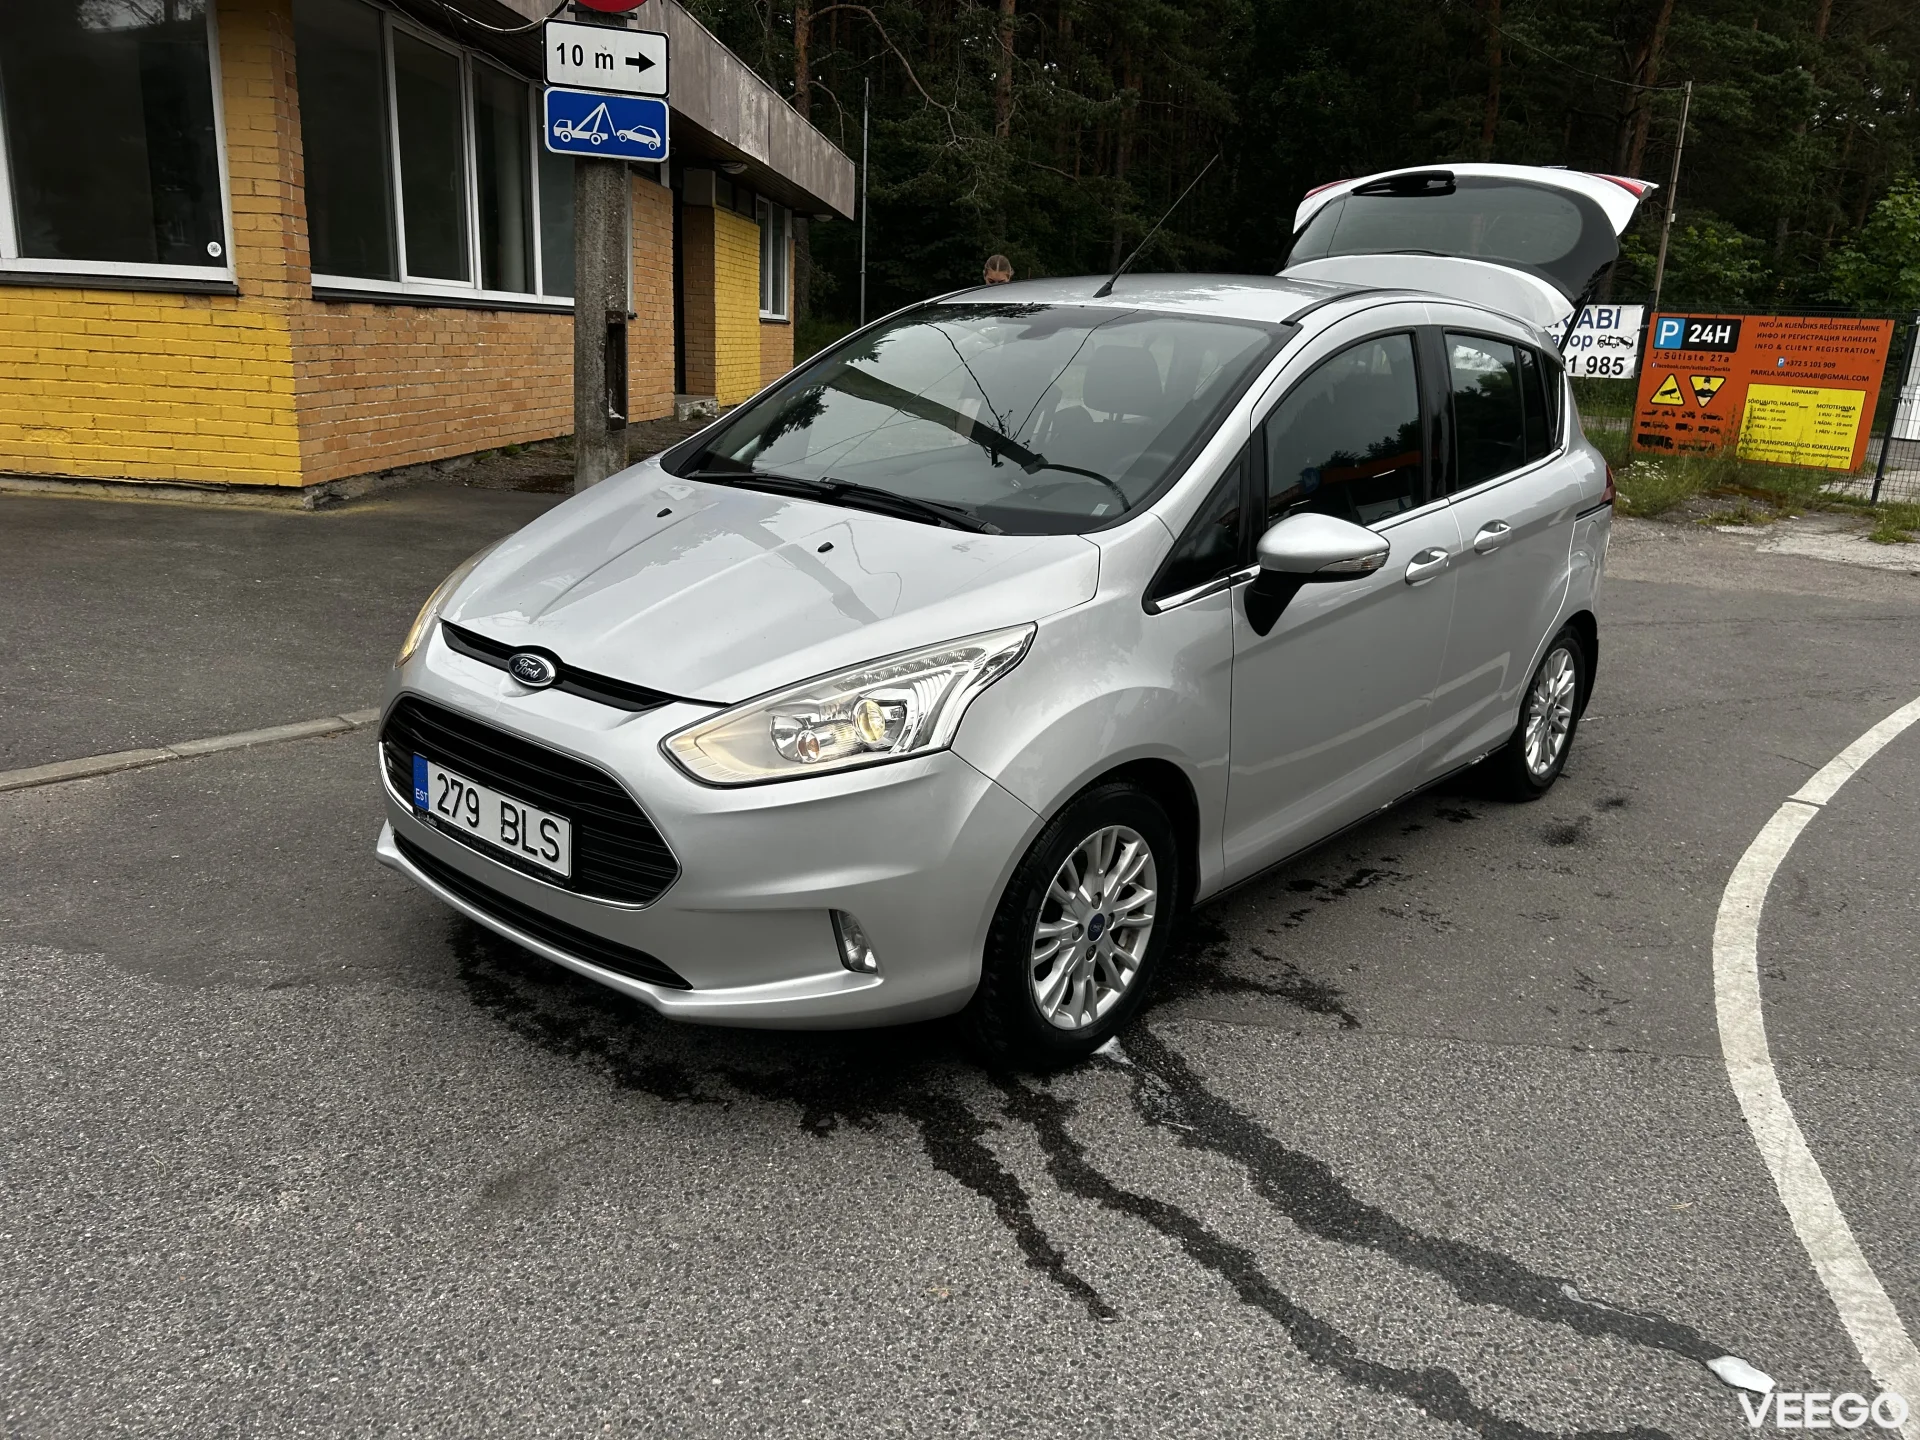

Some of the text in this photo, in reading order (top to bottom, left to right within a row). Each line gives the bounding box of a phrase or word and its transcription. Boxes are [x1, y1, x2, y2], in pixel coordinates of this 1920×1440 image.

[557, 43, 614, 70] 10 m
[1659, 321, 1679, 345] P
[1688, 324, 1731, 344] 24H
[1819, 324, 1880, 332] REGISTREERIMINE
[1710, 354, 1730, 363] 27a
[1785, 344, 1813, 352] CLIENT
[1815, 345, 1876, 354] REGISTRATION
[1586, 356, 1625, 375] 985
[1750, 369, 1869, 382] PARKLA.VARUOSAABI@GMAIL.COM
[515, 658, 541, 678] Ford
[415, 787, 428, 801] EST
[437, 773, 479, 828] 279
[501, 800, 560, 863] BLS
